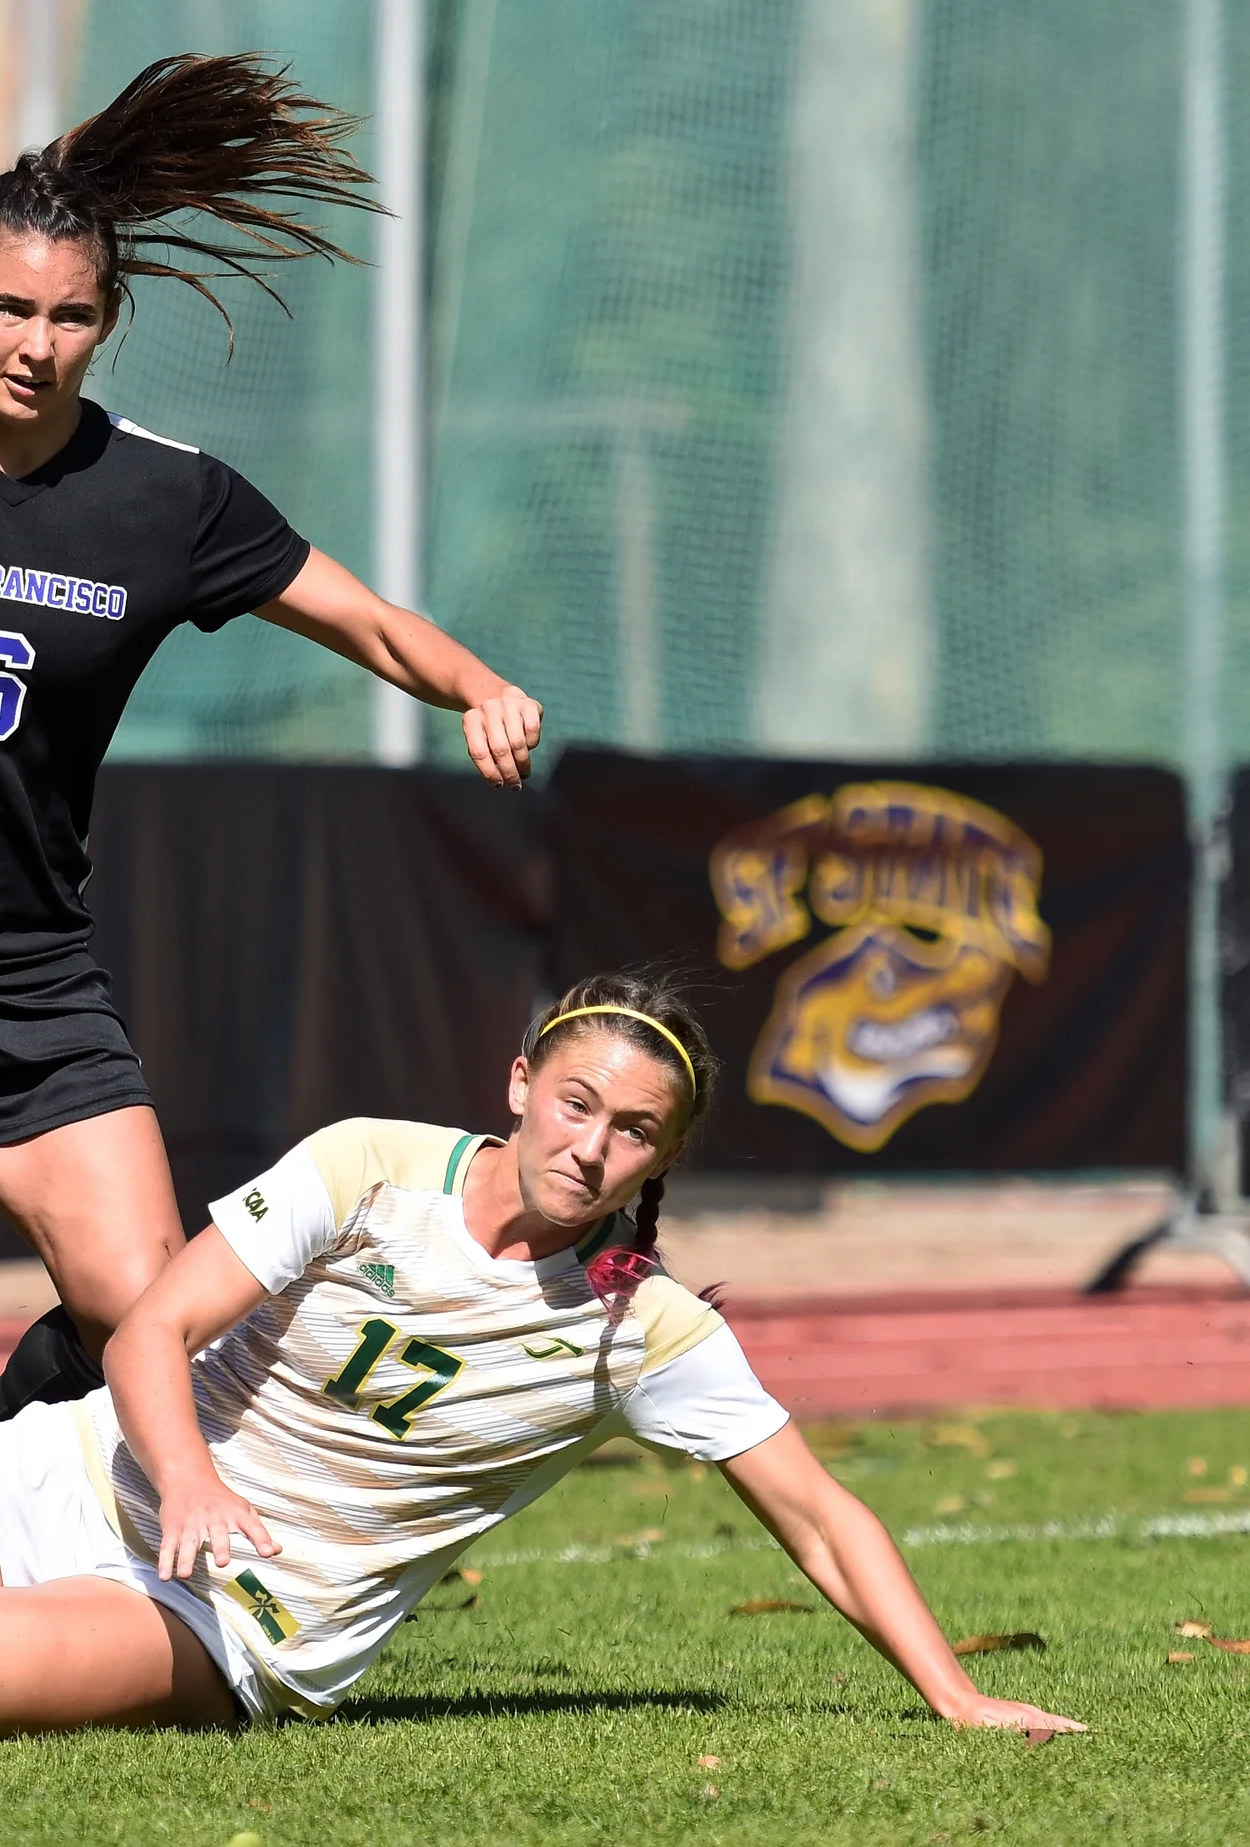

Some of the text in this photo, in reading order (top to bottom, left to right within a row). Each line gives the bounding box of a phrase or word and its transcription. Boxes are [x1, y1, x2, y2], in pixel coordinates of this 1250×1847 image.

[808, 780, 1053, 985] STATE
[357, 1262, 396, 1298] adidas
[320, 1316, 468, 1442] 17
